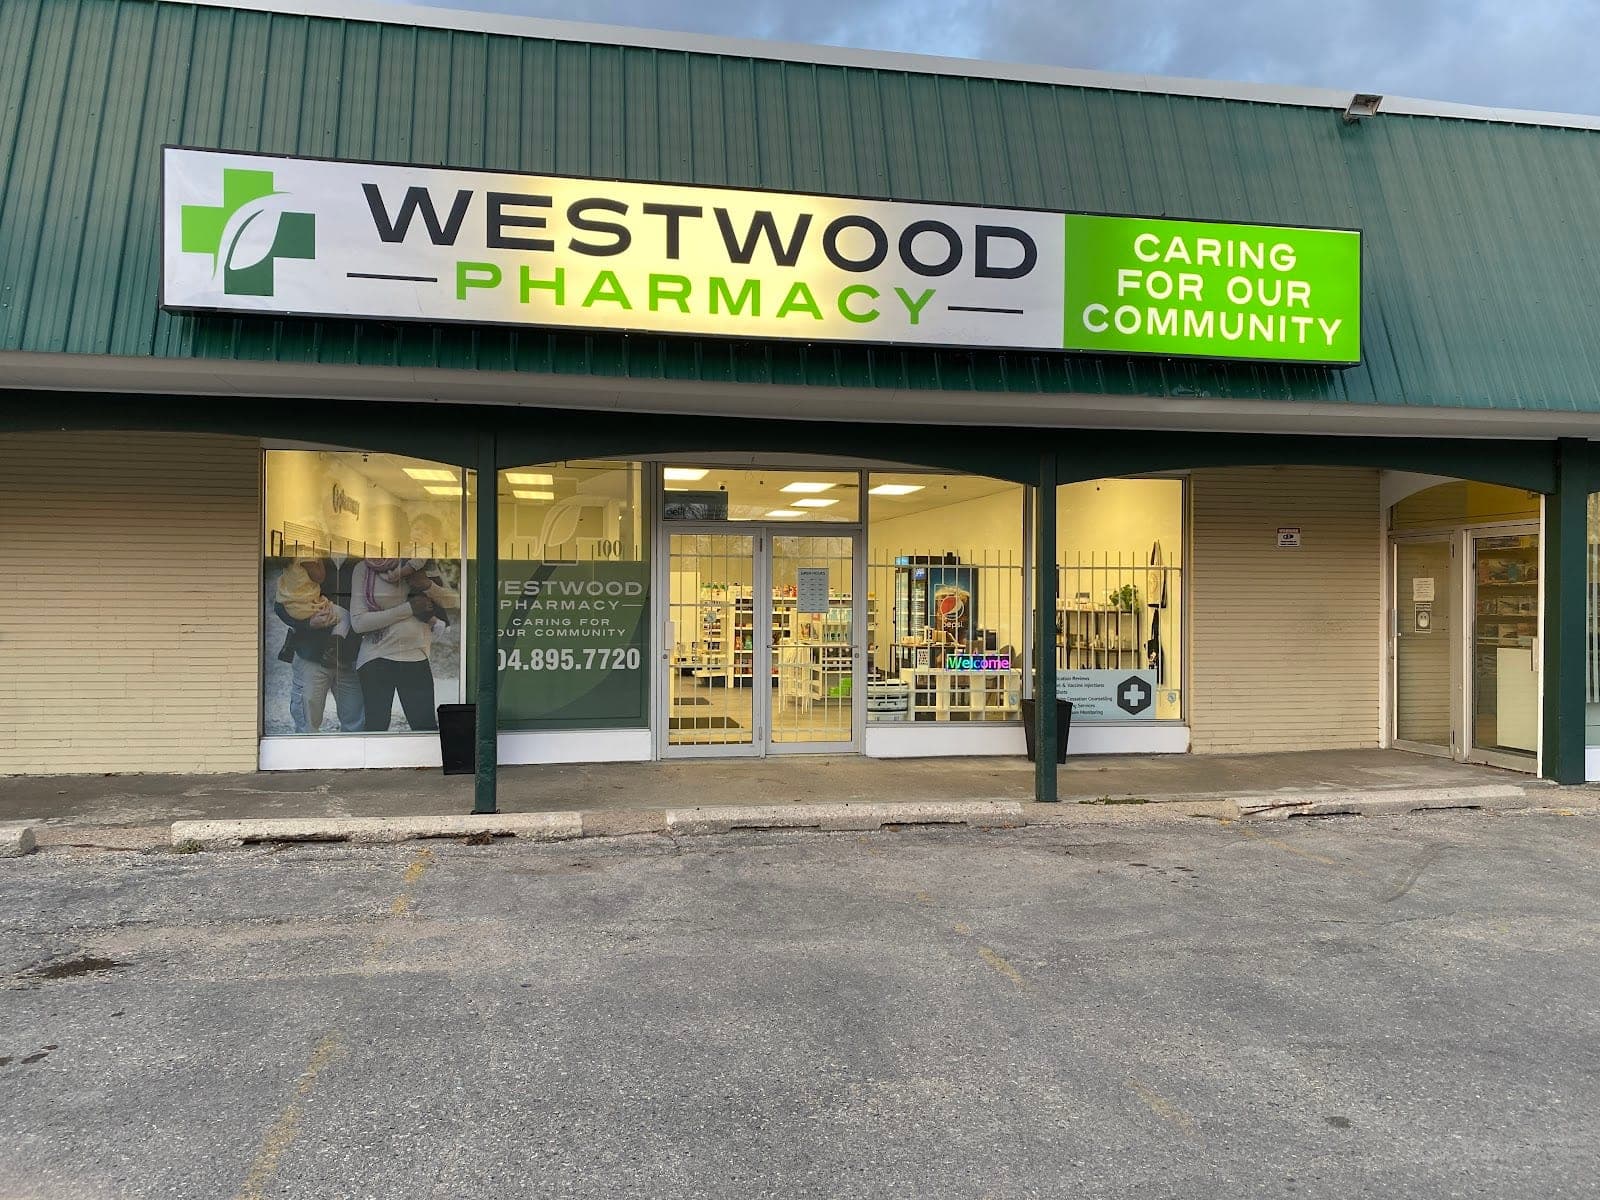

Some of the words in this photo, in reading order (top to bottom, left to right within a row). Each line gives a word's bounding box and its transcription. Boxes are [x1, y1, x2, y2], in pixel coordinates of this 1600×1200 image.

[362, 183, 1037, 279] WESTWOOD
[1134, 233, 1296, 271] CARING
[456, 261, 937, 325] PHARMACY
[1118, 268, 1204, 301] FOR
[1227, 276, 1311, 308] OUR
[1082, 303, 1342, 345] COMMUNITY
[597, 540, 622, 557] 100
[497, 580, 643, 596] ESTWOOD
[500, 600, 620, 611] PHARMACY
[512, 618, 572, 626] CARING
[580, 618, 610, 626] FOR
[534, 628, 626, 637] COMMUNITY
[498, 648, 640, 670] 04.895.7720
[948, 656, 1009, 669] Welcome
